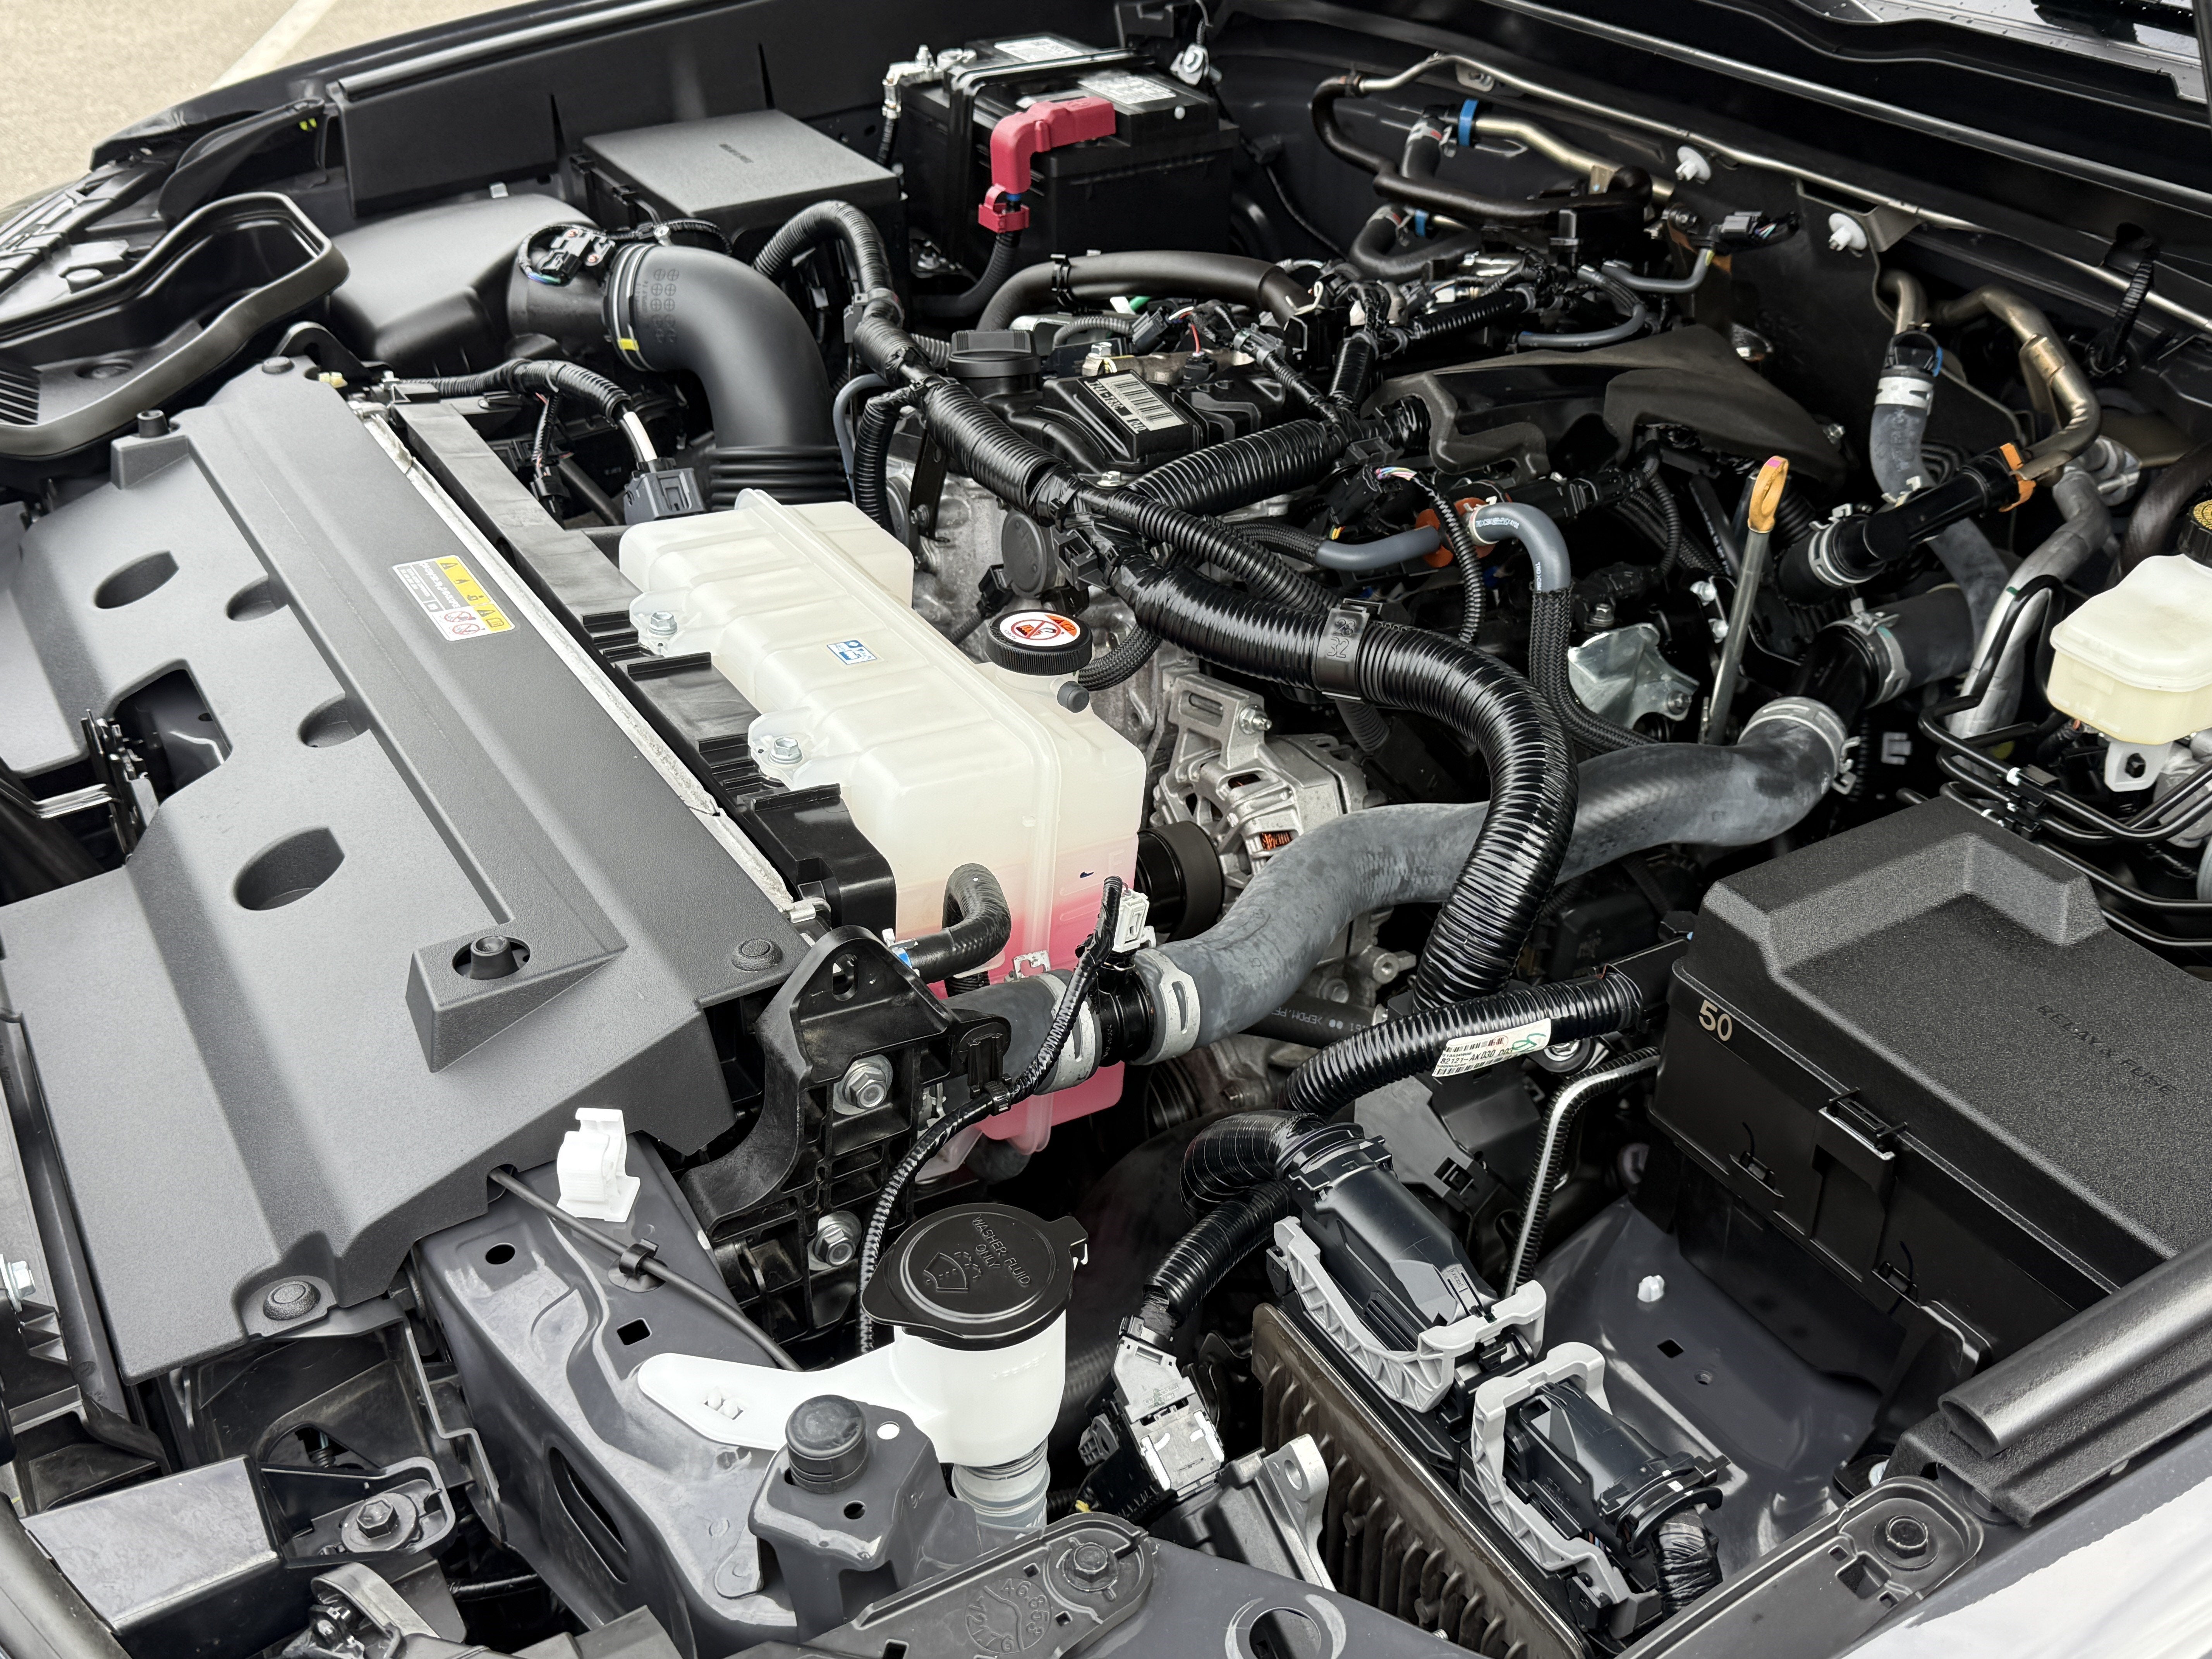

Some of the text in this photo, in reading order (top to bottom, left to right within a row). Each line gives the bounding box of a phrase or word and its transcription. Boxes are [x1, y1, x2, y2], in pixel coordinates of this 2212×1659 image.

[1333, 619, 1356, 636] 28
[1327, 636, 1349, 658] 32
[1698, 999, 1733, 1041] 50
[2036, 1005, 2105, 1045] RELAY
[2119, 1059, 2178, 1096] FUSE
[972, 1216, 1030, 1284] WASHER FLUID
[975, 1244, 1001, 1267] ONLY
